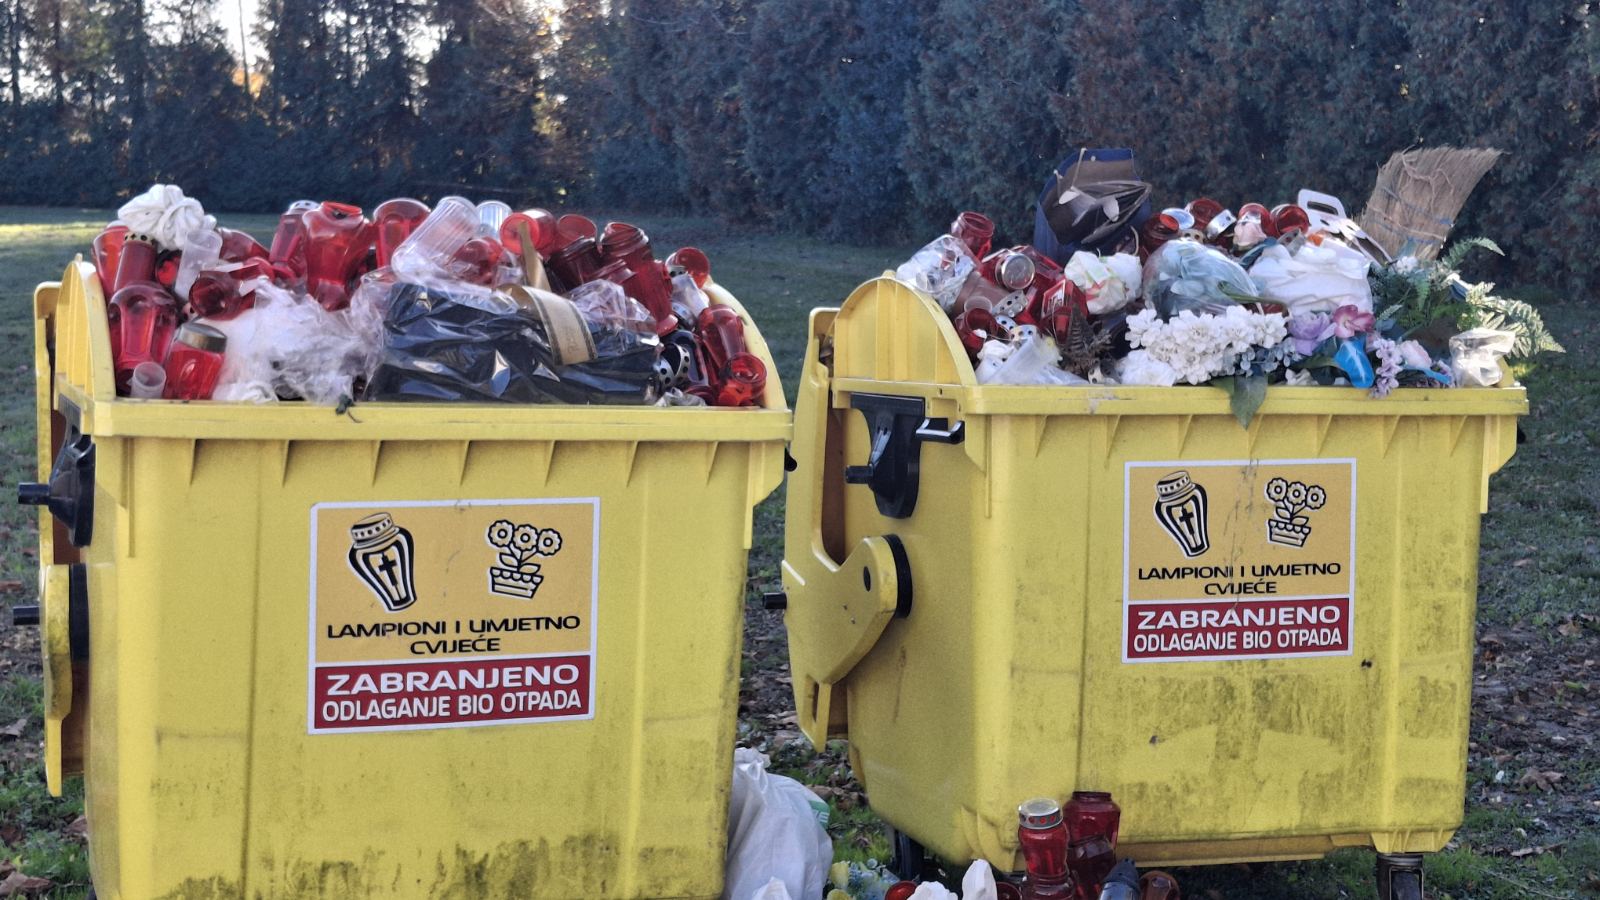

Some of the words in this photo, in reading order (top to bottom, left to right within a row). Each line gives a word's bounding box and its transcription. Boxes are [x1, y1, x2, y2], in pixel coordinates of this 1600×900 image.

[1138, 565, 1233, 580] LAMPIONI
[1240, 566, 1244, 577] I
[1252, 562, 1341, 577] UMJETNO
[1204, 578, 1277, 595] CVIJEĆE
[327, 621, 447, 639] LAMPIONI
[455, 621, 460, 633] I
[469, 615, 581, 632] UMJETNO
[1137, 606, 1341, 630] ZABRANJENO
[410, 634, 501, 654] CVIJEĆE
[1133, 630, 1237, 652] ODLAGANJE
[1242, 630, 1272, 649] BIO
[1277, 627, 1342, 648] OTPADA
[327, 664, 579, 696] ZABRANJENO
[322, 695, 451, 721] ODLAGANJE
[458, 693, 494, 715] BIO
[500, 689, 582, 713] OTPADA
